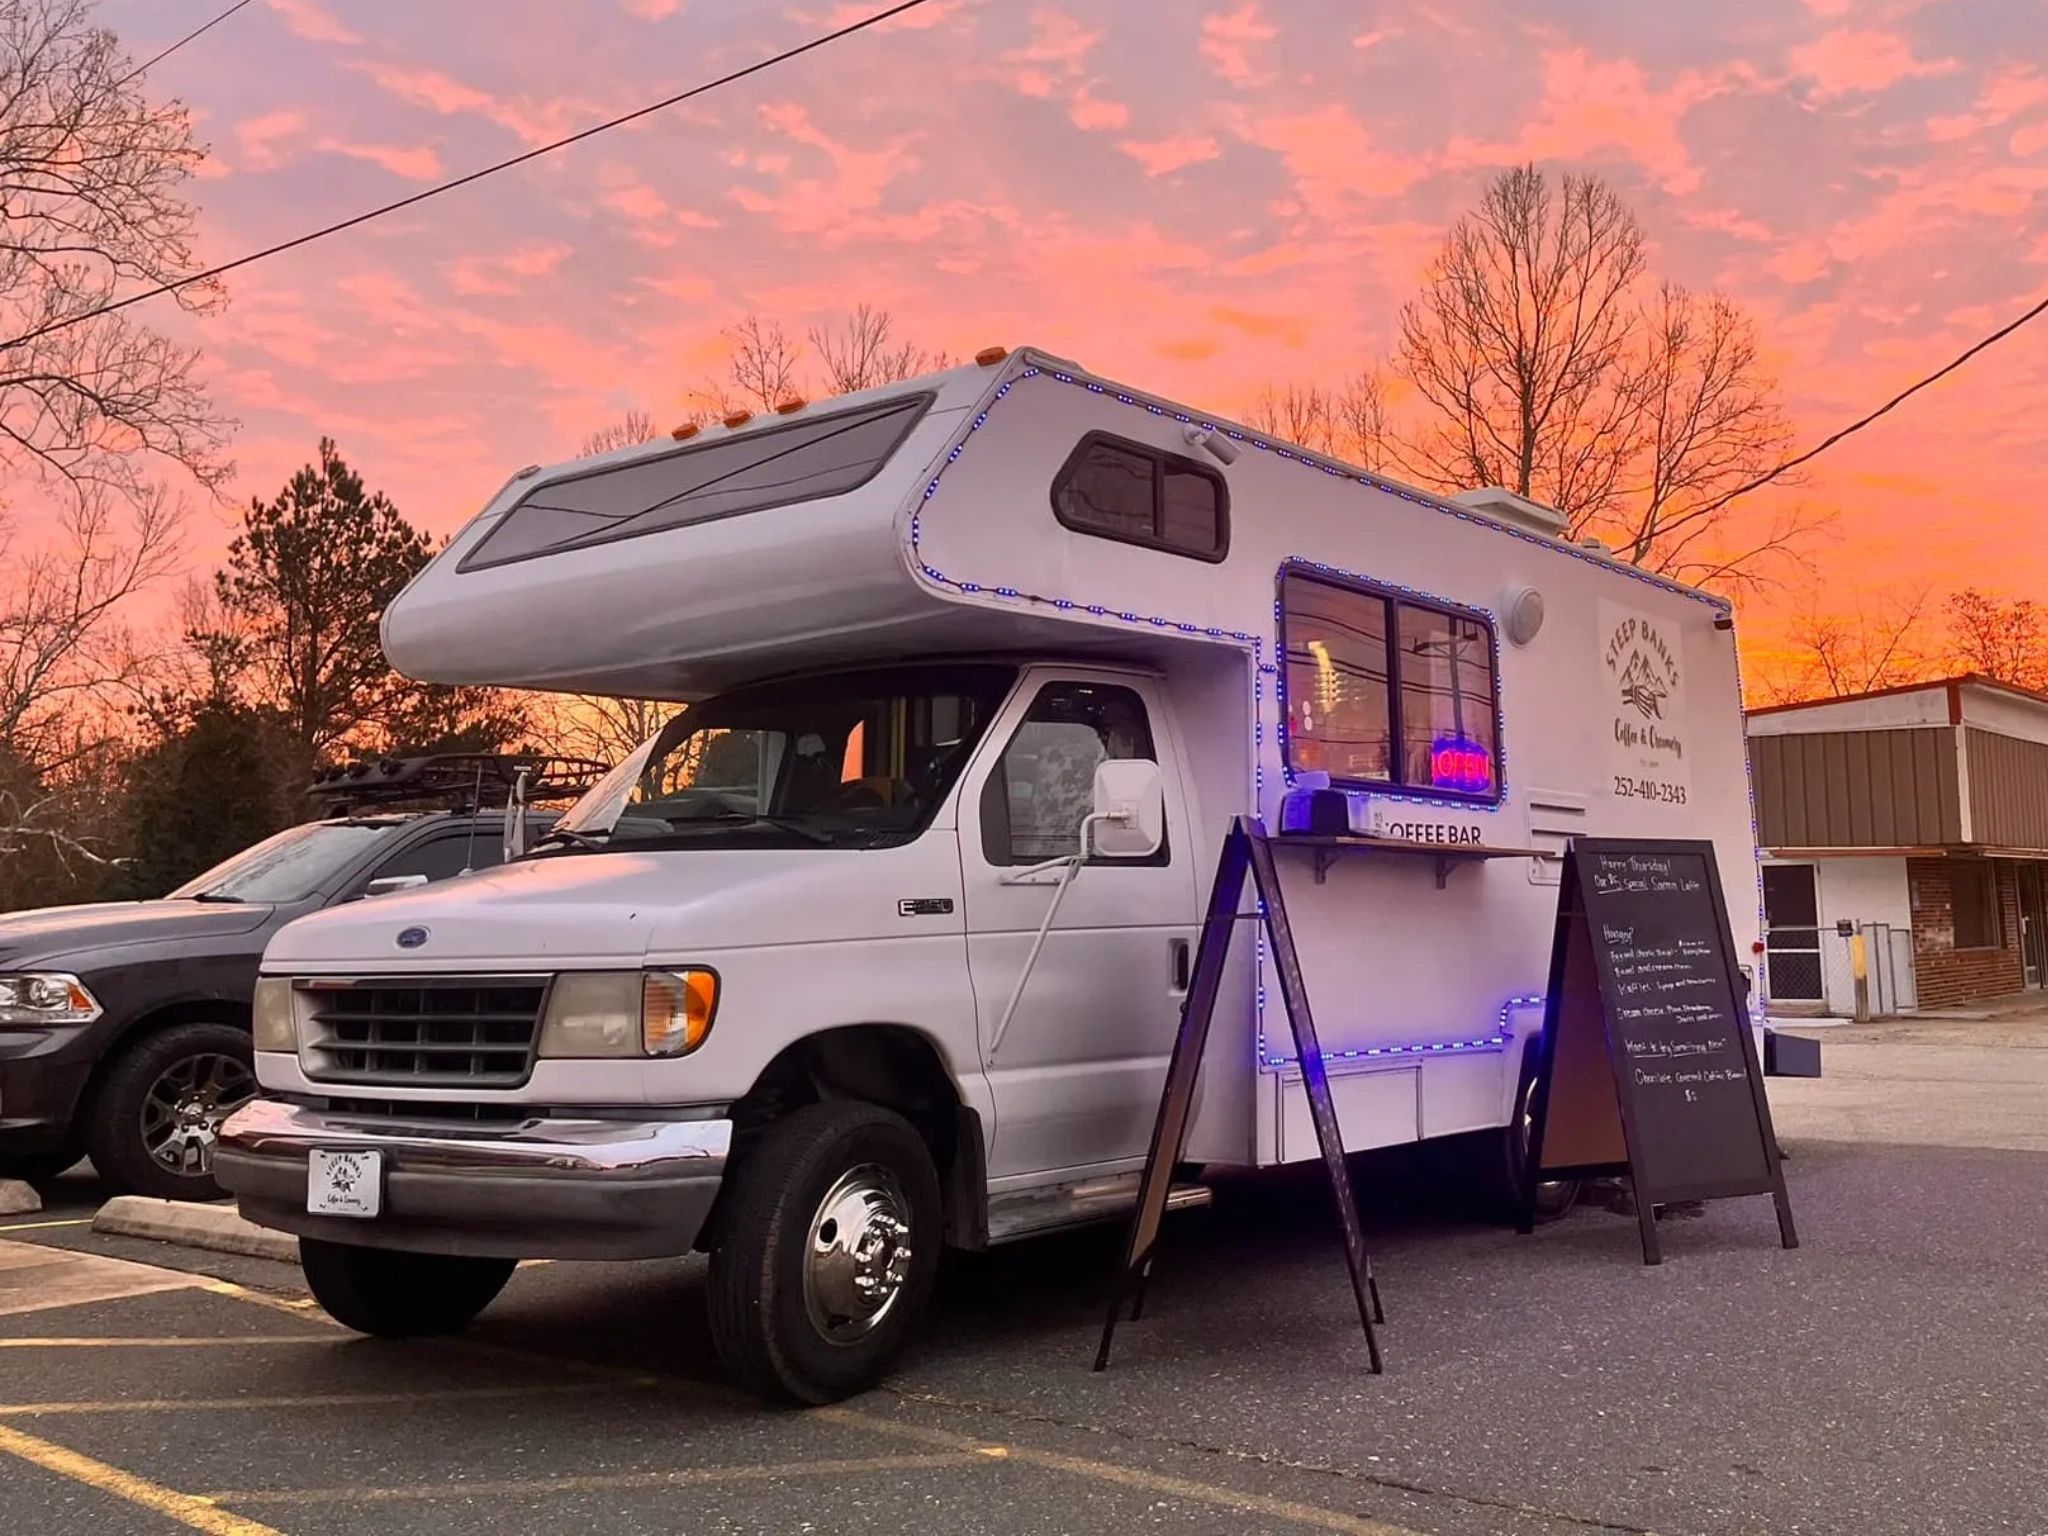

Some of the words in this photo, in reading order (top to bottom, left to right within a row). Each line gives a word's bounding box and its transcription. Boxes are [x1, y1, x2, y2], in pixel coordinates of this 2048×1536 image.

[1606, 618, 1636, 673] STEEP
[1641, 620, 1680, 687] BANKS
[1615, 717, 1638, 748] Coffee
[1640, 727, 1648, 745] &
[1438, 750, 1489, 780] OPEN
[1614, 776, 1687, 804] 252-410-2343
[1386, 822, 1445, 844] OFFEE
[1449, 824, 1482, 845] BAR
